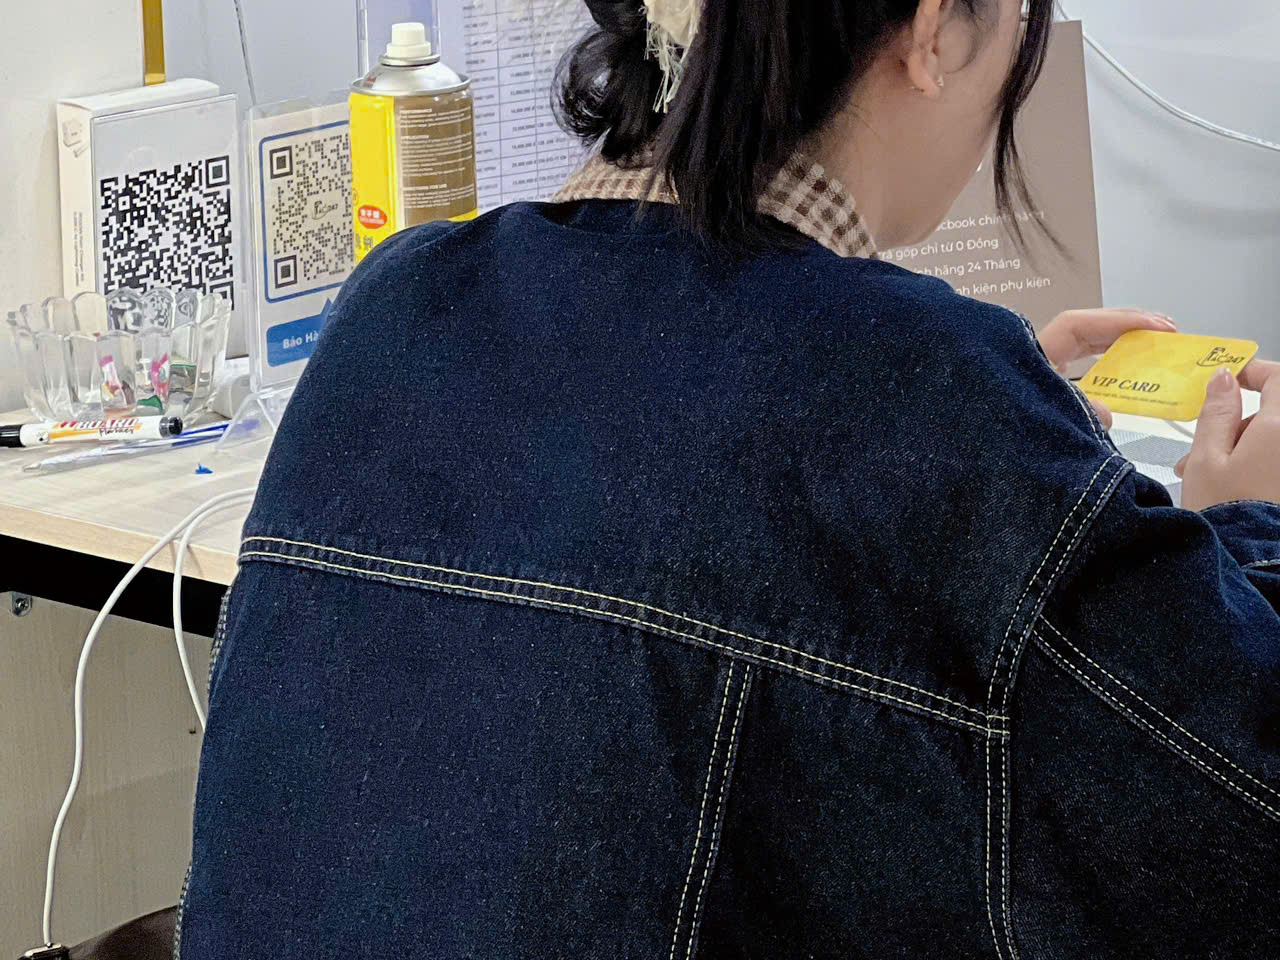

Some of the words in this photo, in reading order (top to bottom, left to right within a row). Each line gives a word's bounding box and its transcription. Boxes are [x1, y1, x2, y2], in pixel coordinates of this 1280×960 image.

[967, 262, 981, 271] 24
[282, 335, 303, 350] Bảo
[1092, 376, 1118, 387] VIP
[1118, 379, 1161, 393] CARD
